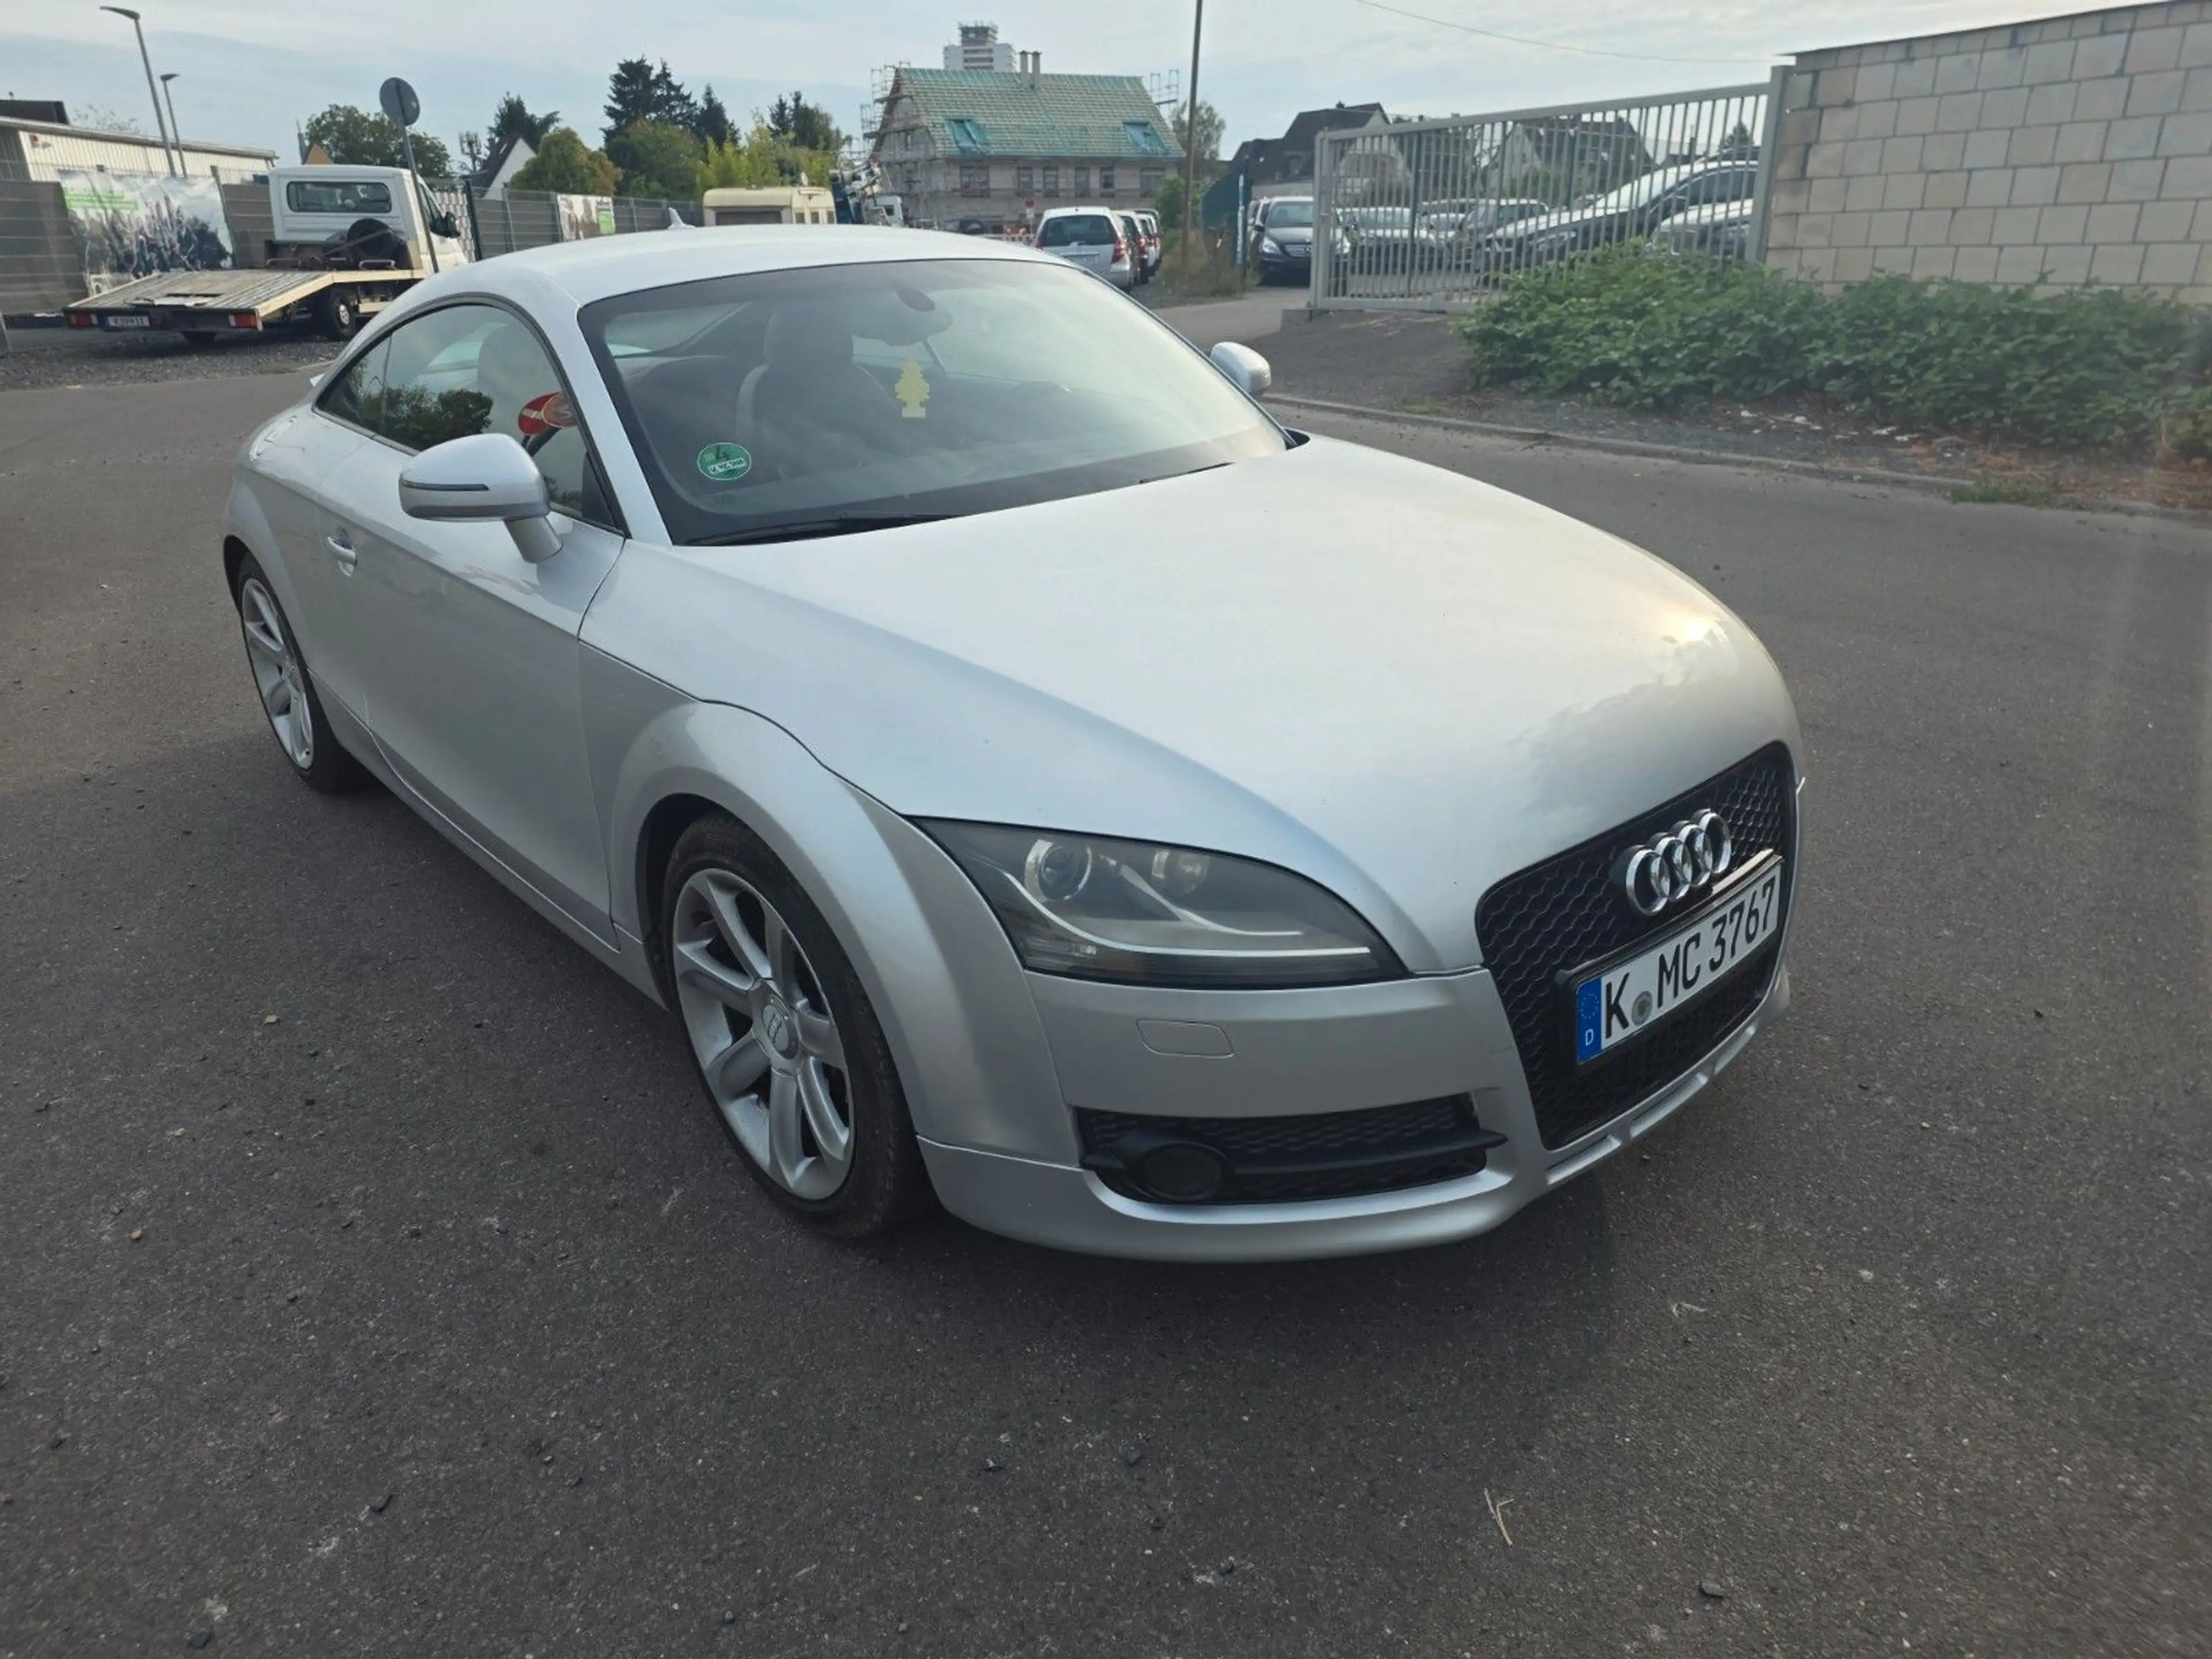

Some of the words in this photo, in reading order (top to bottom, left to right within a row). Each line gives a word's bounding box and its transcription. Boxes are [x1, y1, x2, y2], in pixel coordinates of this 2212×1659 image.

[1605, 973, 1630, 1039] K
[1657, 934, 1702, 1009] MC
[1709, 876, 1775, 972] 3767
[1585, 1028, 1594, 1047] D
